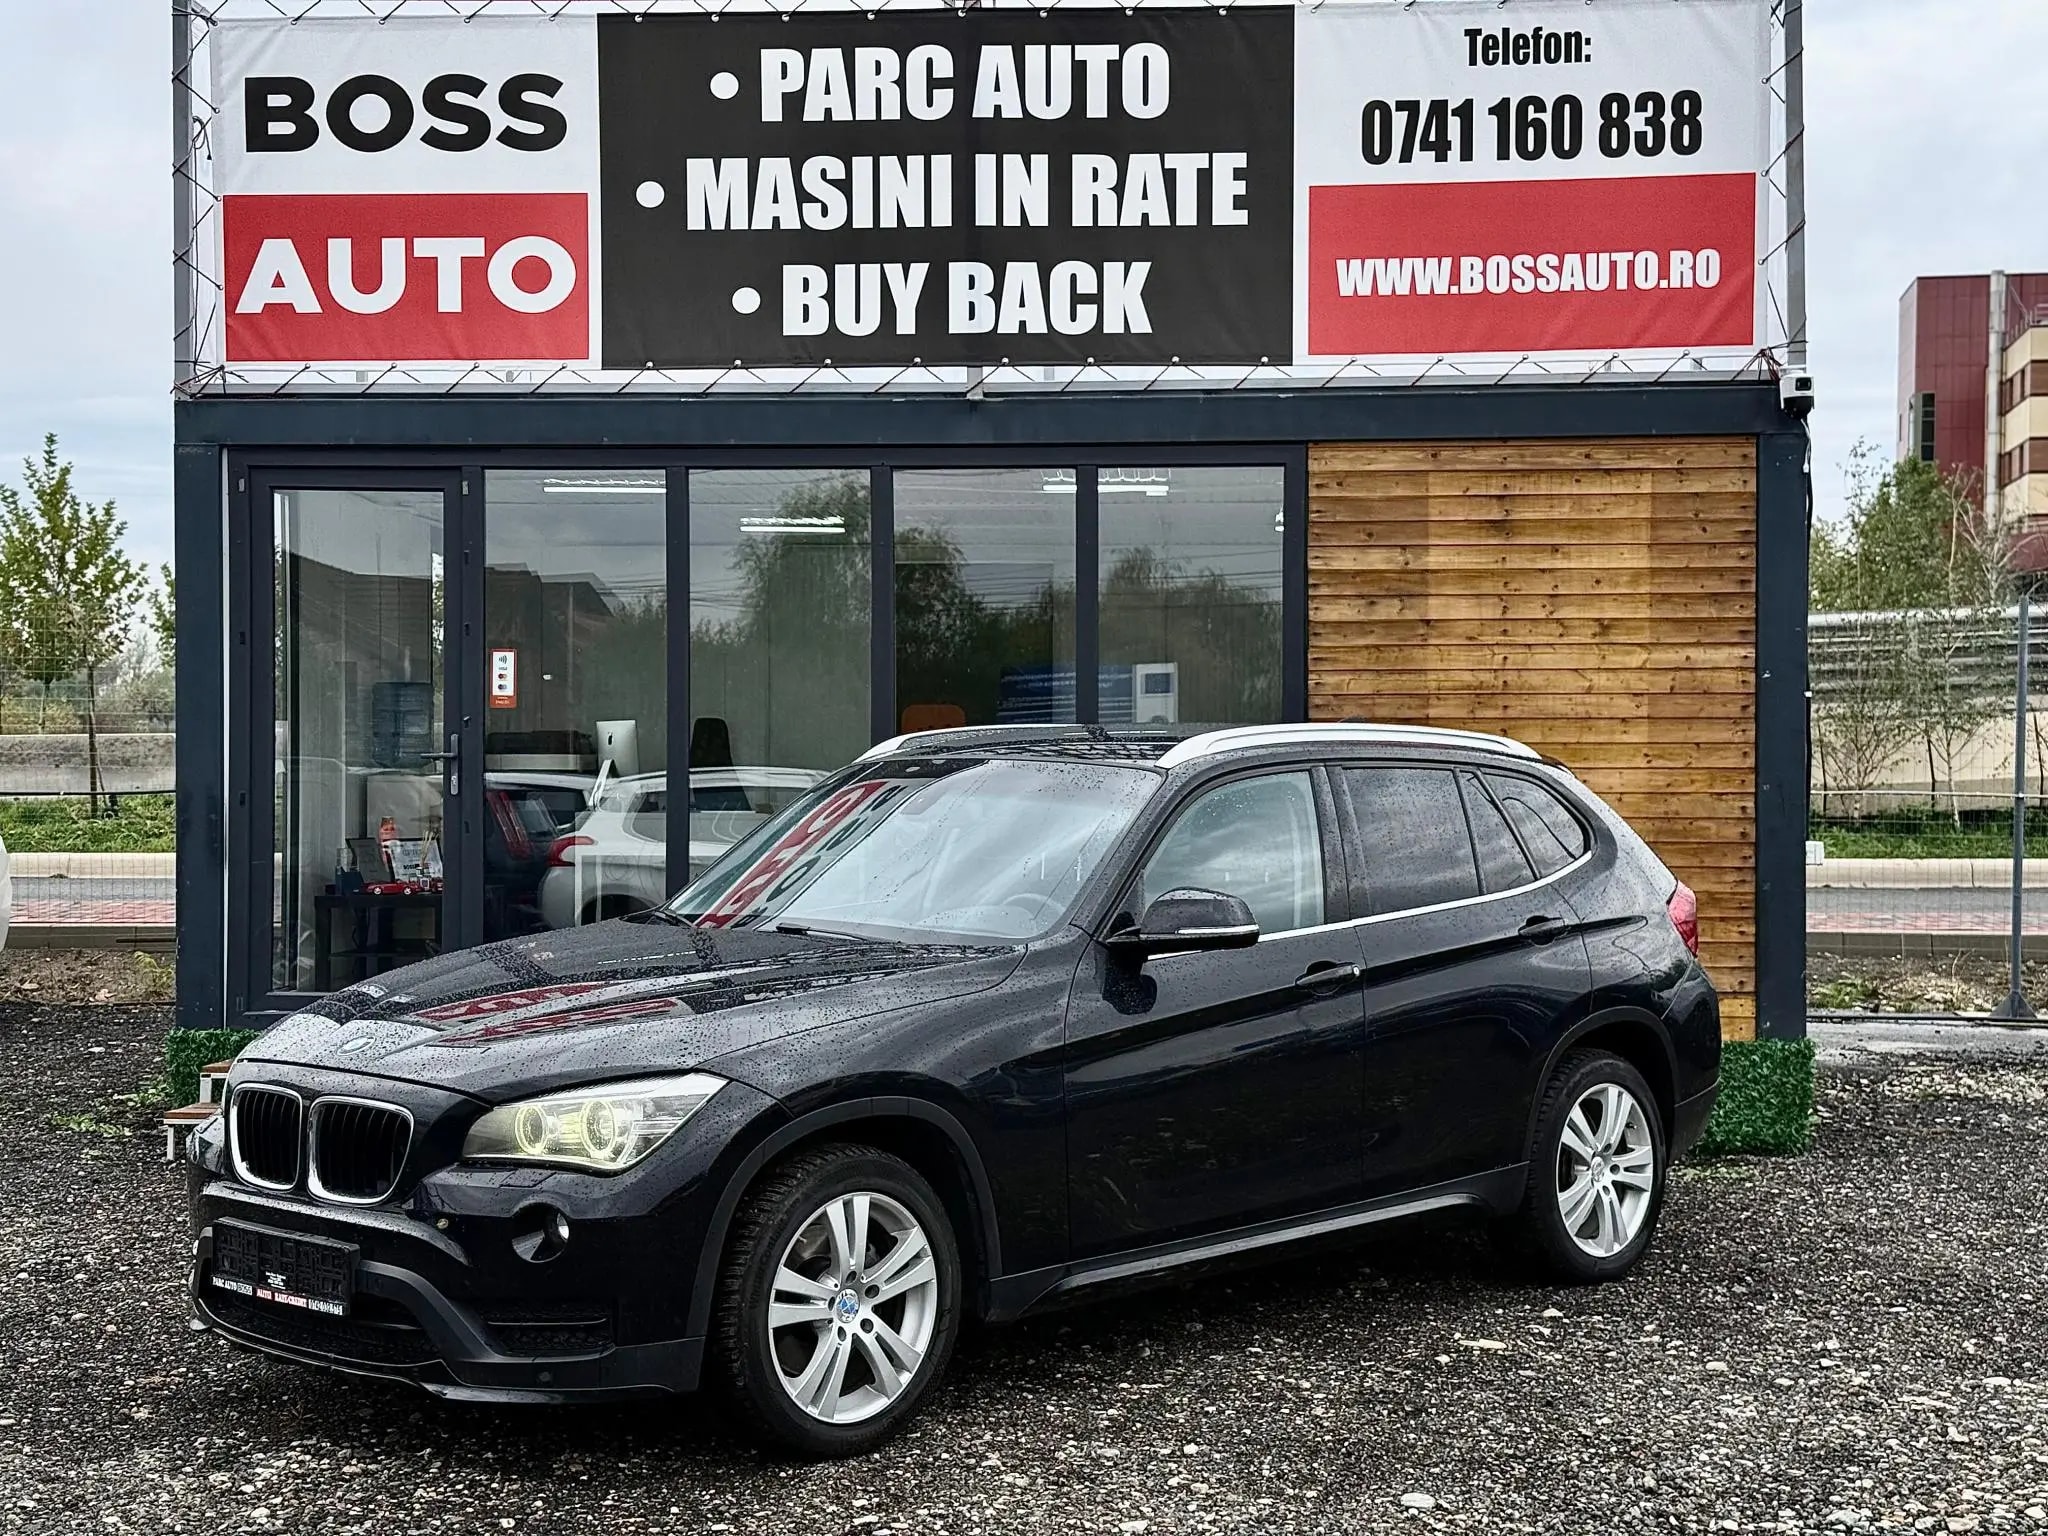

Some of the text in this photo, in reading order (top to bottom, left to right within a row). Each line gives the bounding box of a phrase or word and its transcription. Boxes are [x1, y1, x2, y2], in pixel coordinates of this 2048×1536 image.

[761, 43, 1170, 122] PARC AUTO
[1464, 27, 1592, 66] Telefon:
[244, 73, 568, 153] BOSS
[1361, 90, 1703, 166] 0741 160 838
[686, 152, 1249, 231] MASINI IN RATE
[234, 235, 577, 315] AUTO
[782, 260, 1153, 337] BUY BACK
[1336, 249, 1720, 297] WWW.BOSSAUTO.RO
